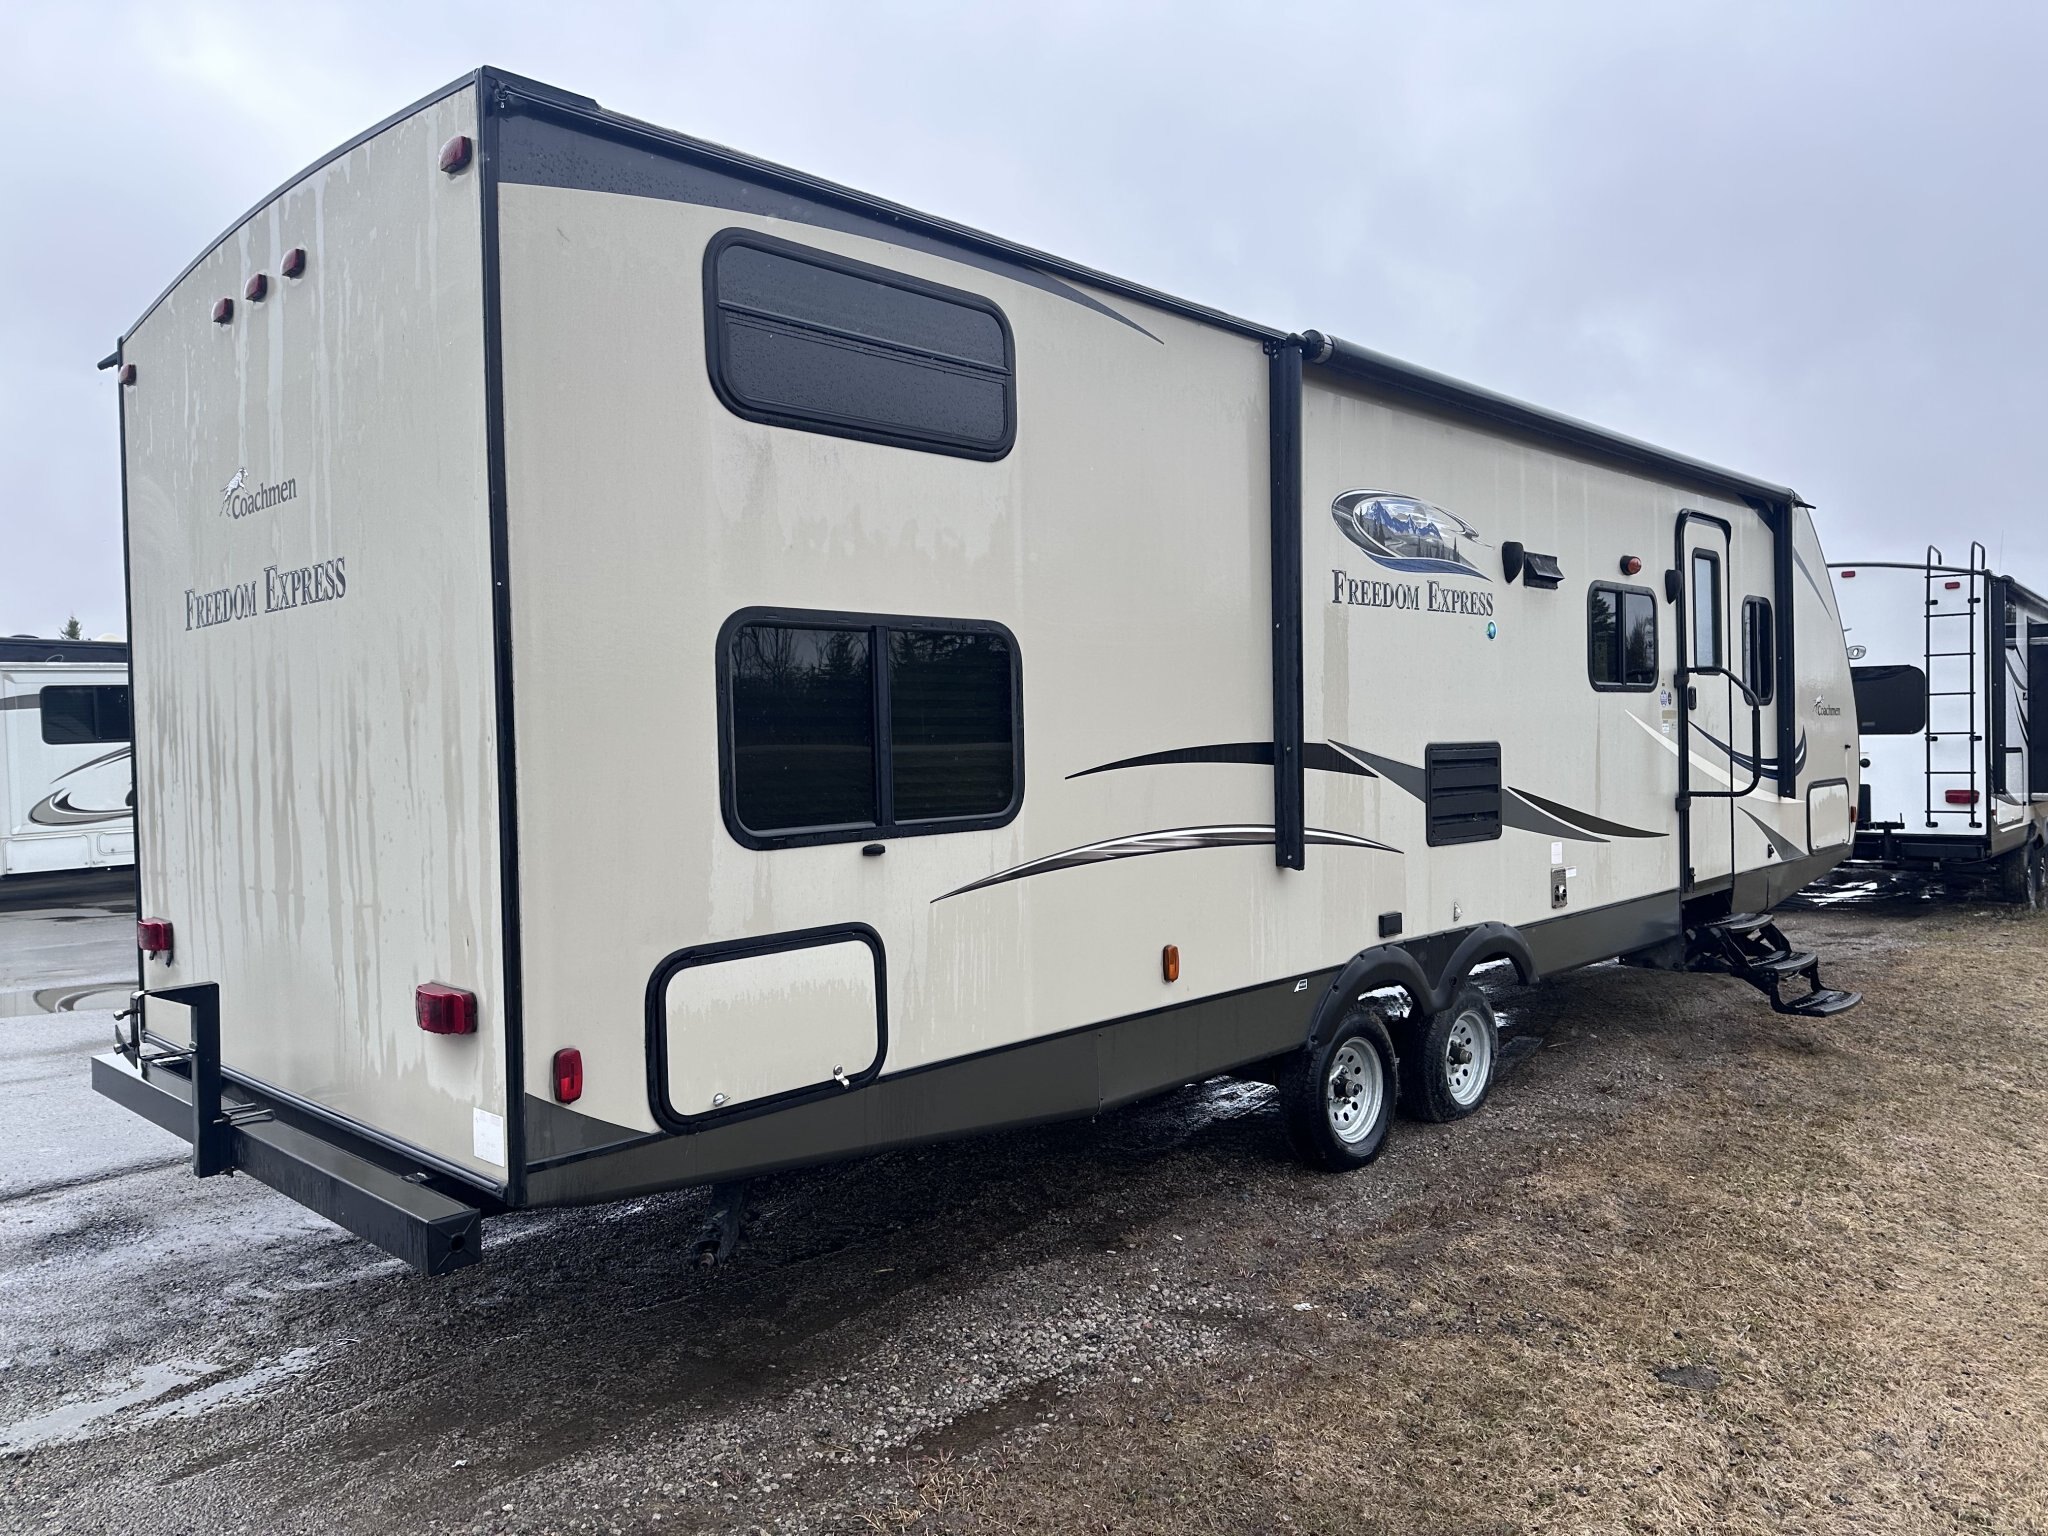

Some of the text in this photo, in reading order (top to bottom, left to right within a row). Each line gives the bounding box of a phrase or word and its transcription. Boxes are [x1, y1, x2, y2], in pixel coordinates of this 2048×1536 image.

[232, 478, 297, 519] Coachmen
[185, 557, 346, 631] FREEDOM EXPRESS
[1332, 569, 1494, 616] FREEDOM EXPRESS
[1817, 704, 1841, 716] Coachmen
